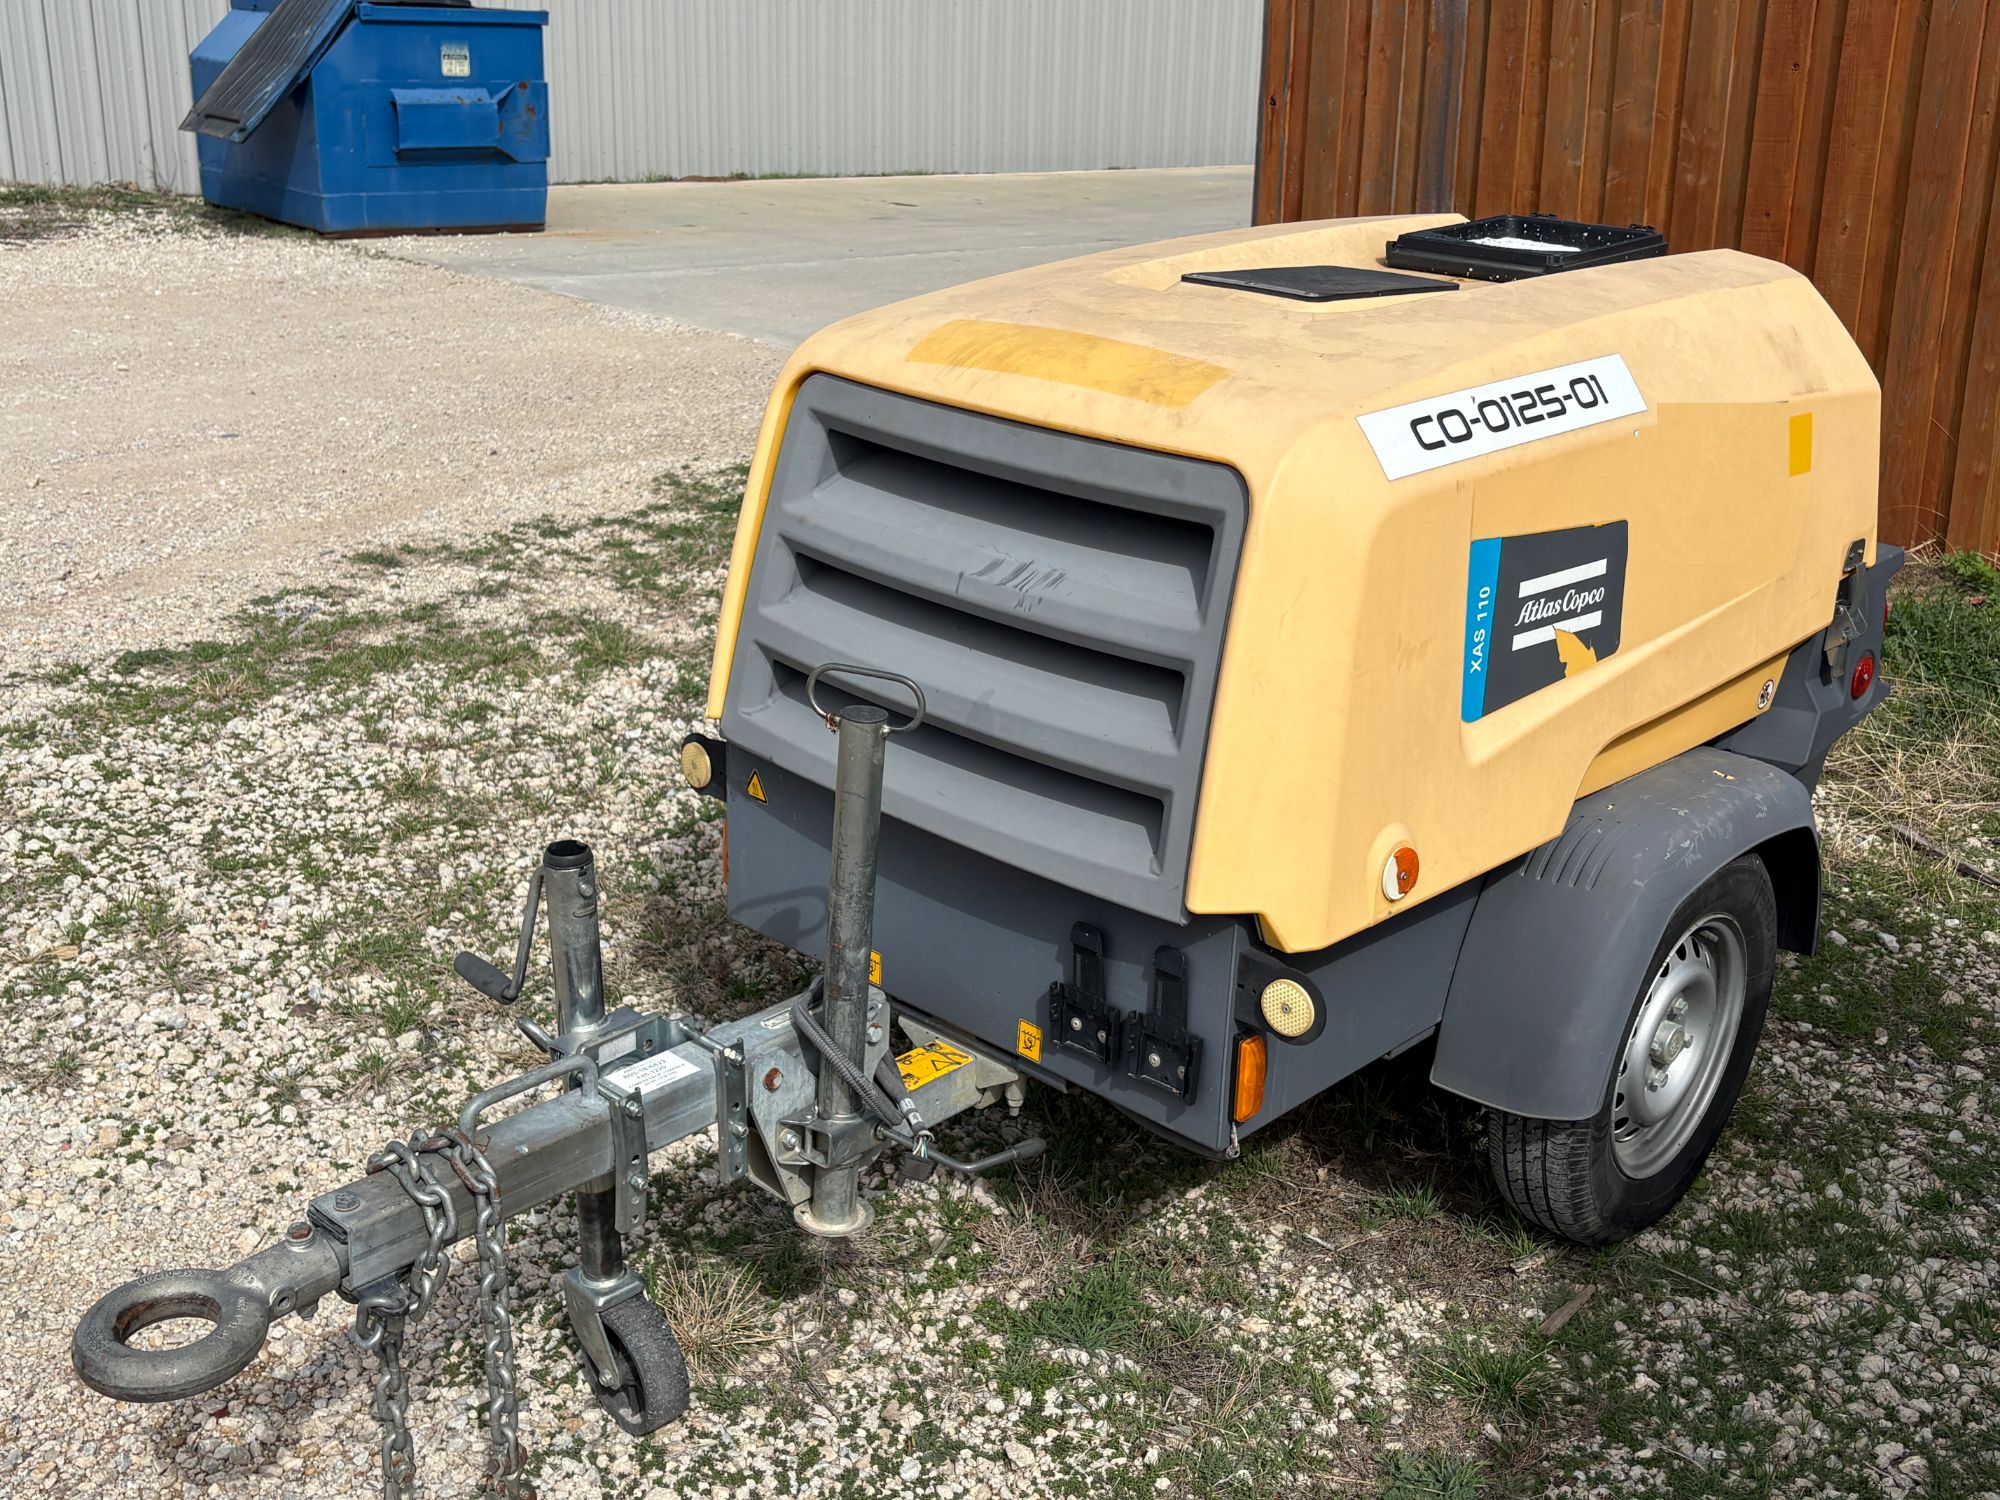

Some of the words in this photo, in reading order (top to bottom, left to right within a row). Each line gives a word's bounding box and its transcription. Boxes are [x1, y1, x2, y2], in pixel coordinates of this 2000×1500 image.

[1410, 374, 1609, 451] CO-0125-01
[1477, 586, 1491, 622] 110
[1514, 598, 1561, 627] Atlas
[1562, 587, 1605, 617] Copco
[1470, 630, 1486, 674] XAS
